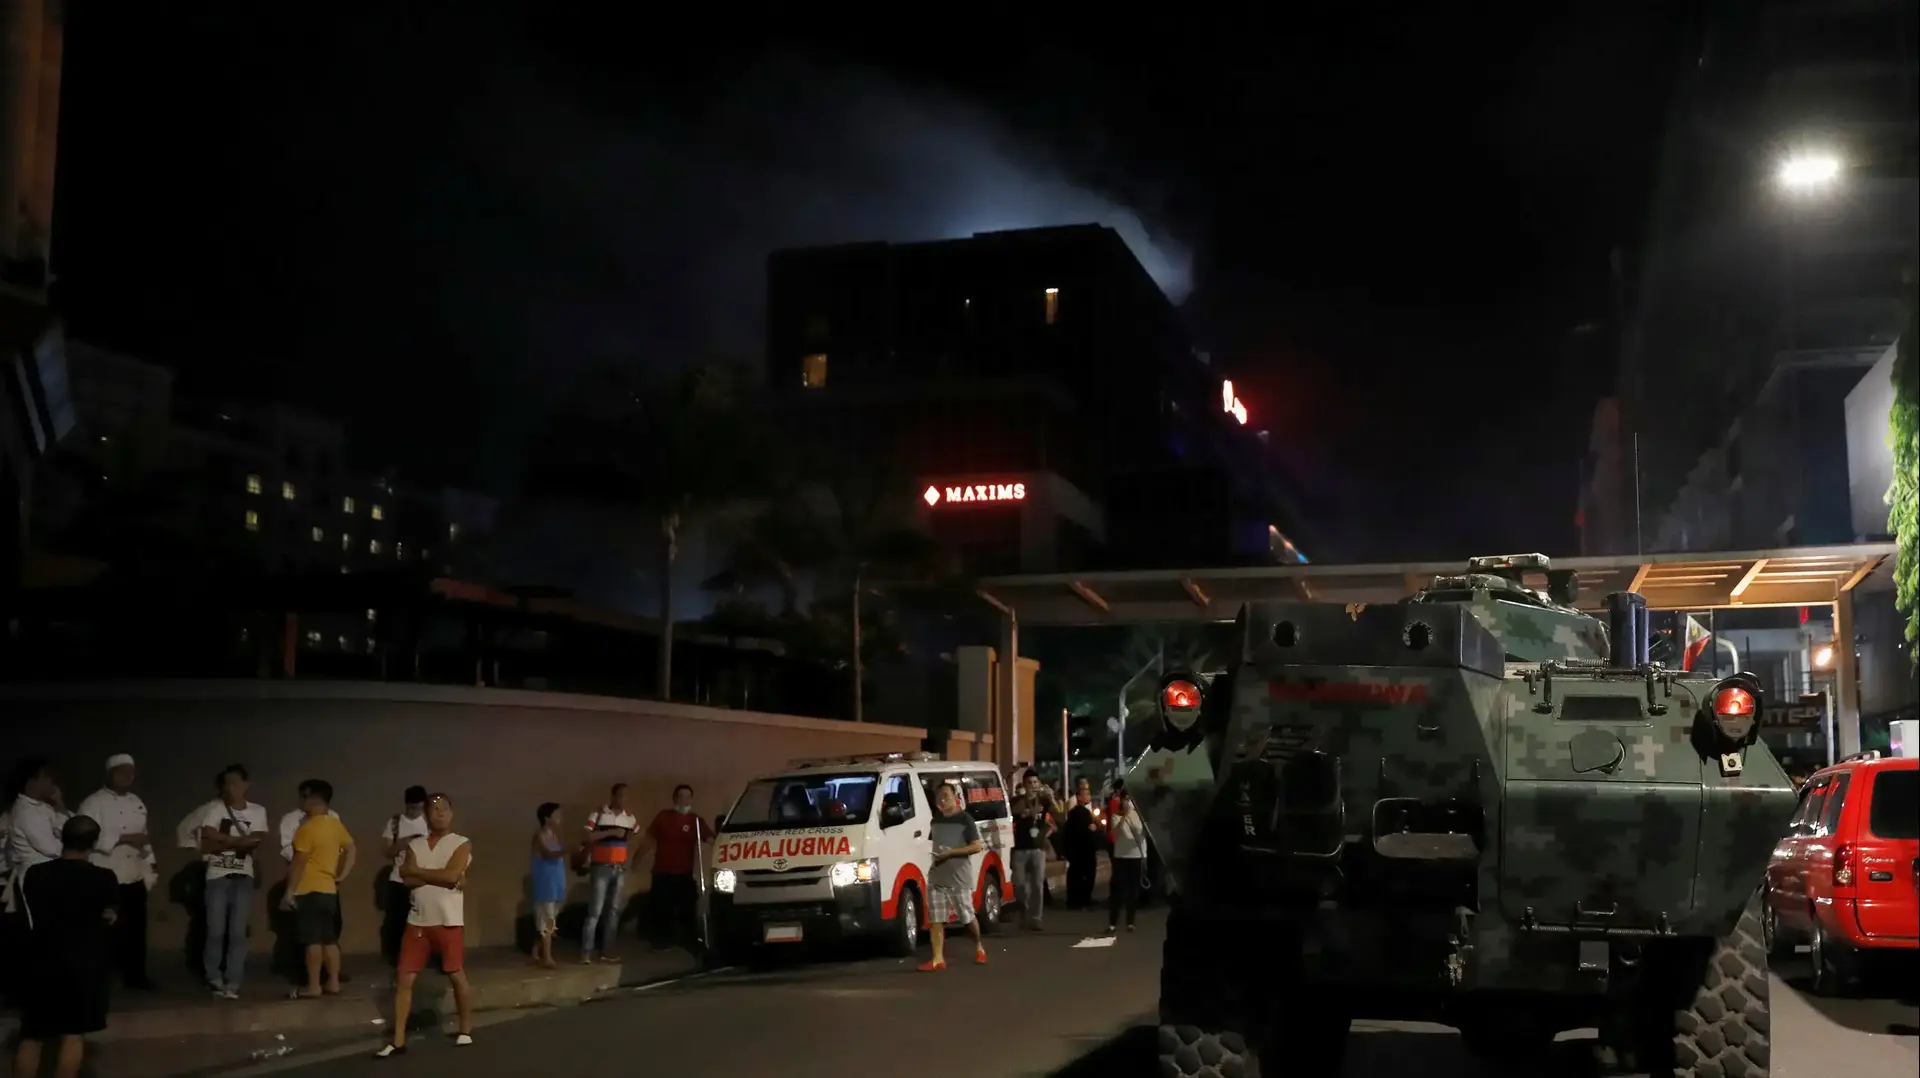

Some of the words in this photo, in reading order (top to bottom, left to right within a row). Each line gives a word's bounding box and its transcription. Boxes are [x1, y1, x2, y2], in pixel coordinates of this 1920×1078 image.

[945, 483, 1026, 502] MAXIMS
[729, 829, 781, 840] PHILIPPINE
[784, 826, 806, 836] RED
[807, 826, 844, 835] CROSS
